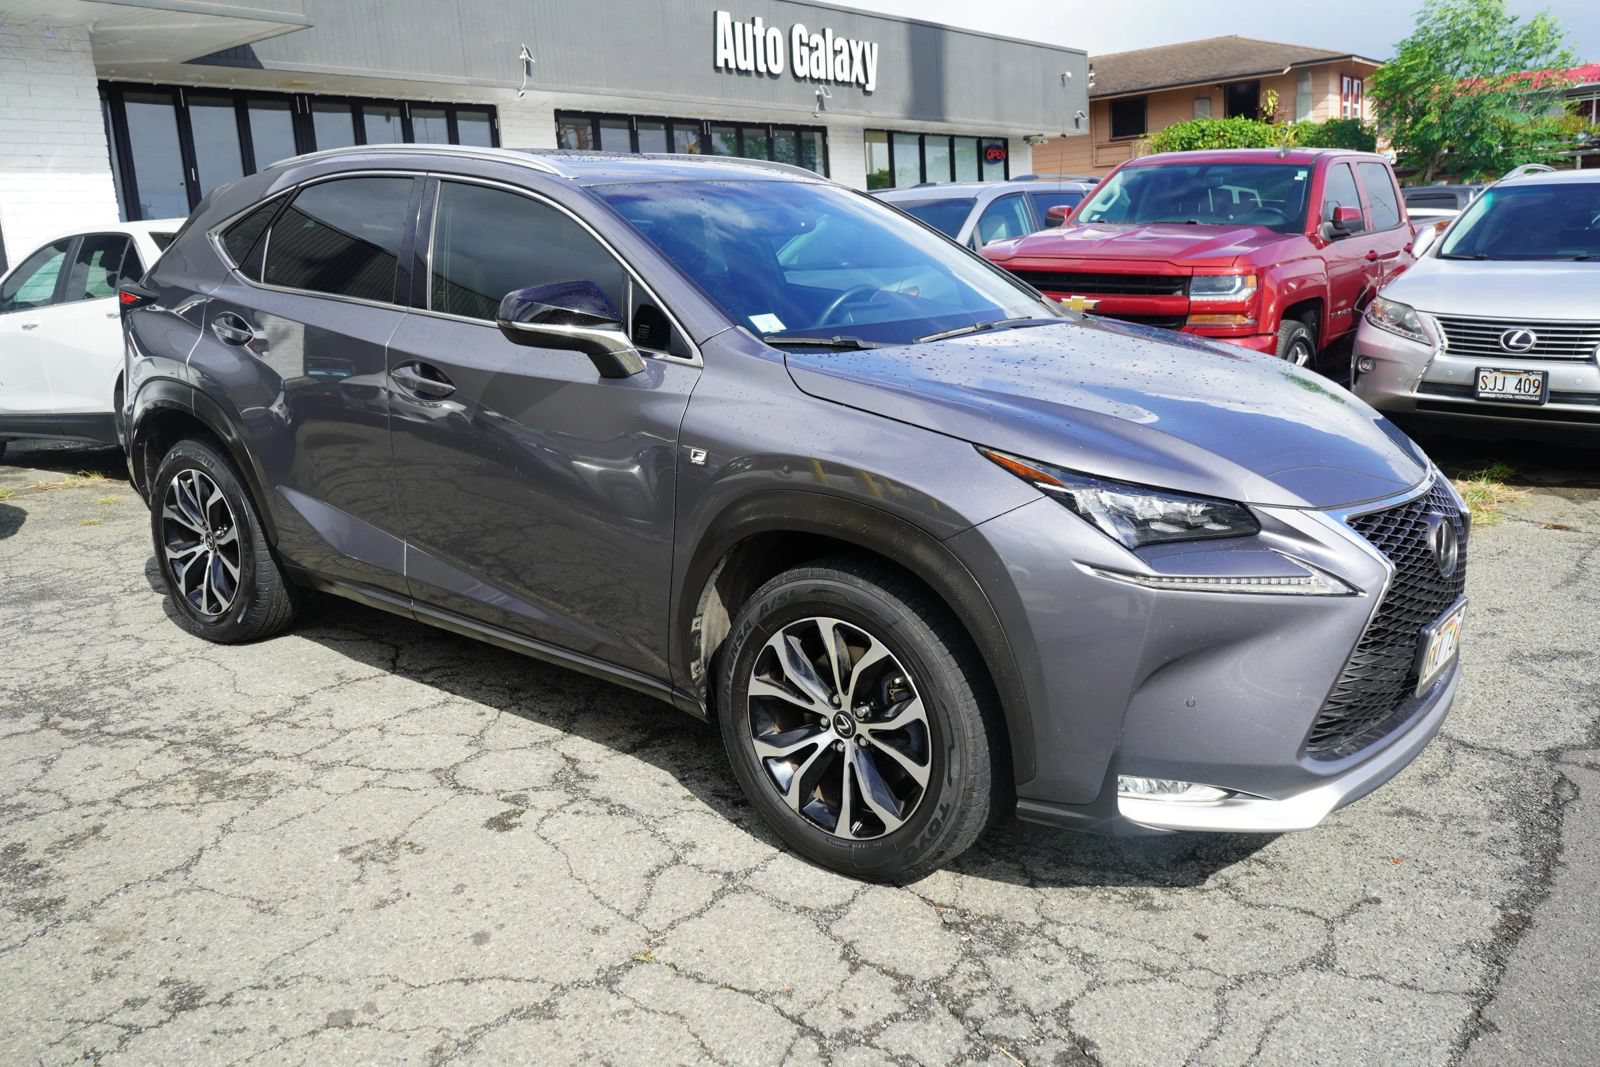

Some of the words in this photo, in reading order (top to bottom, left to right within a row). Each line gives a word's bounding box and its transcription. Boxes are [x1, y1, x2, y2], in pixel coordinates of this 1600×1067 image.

[714, 10, 785, 76] Auto
[790, 23, 879, 92] Galaxy
[986, 148, 1006, 160] OPEN
[1480, 375, 1506, 392] SJJ
[1514, 377, 1541, 394] 409
